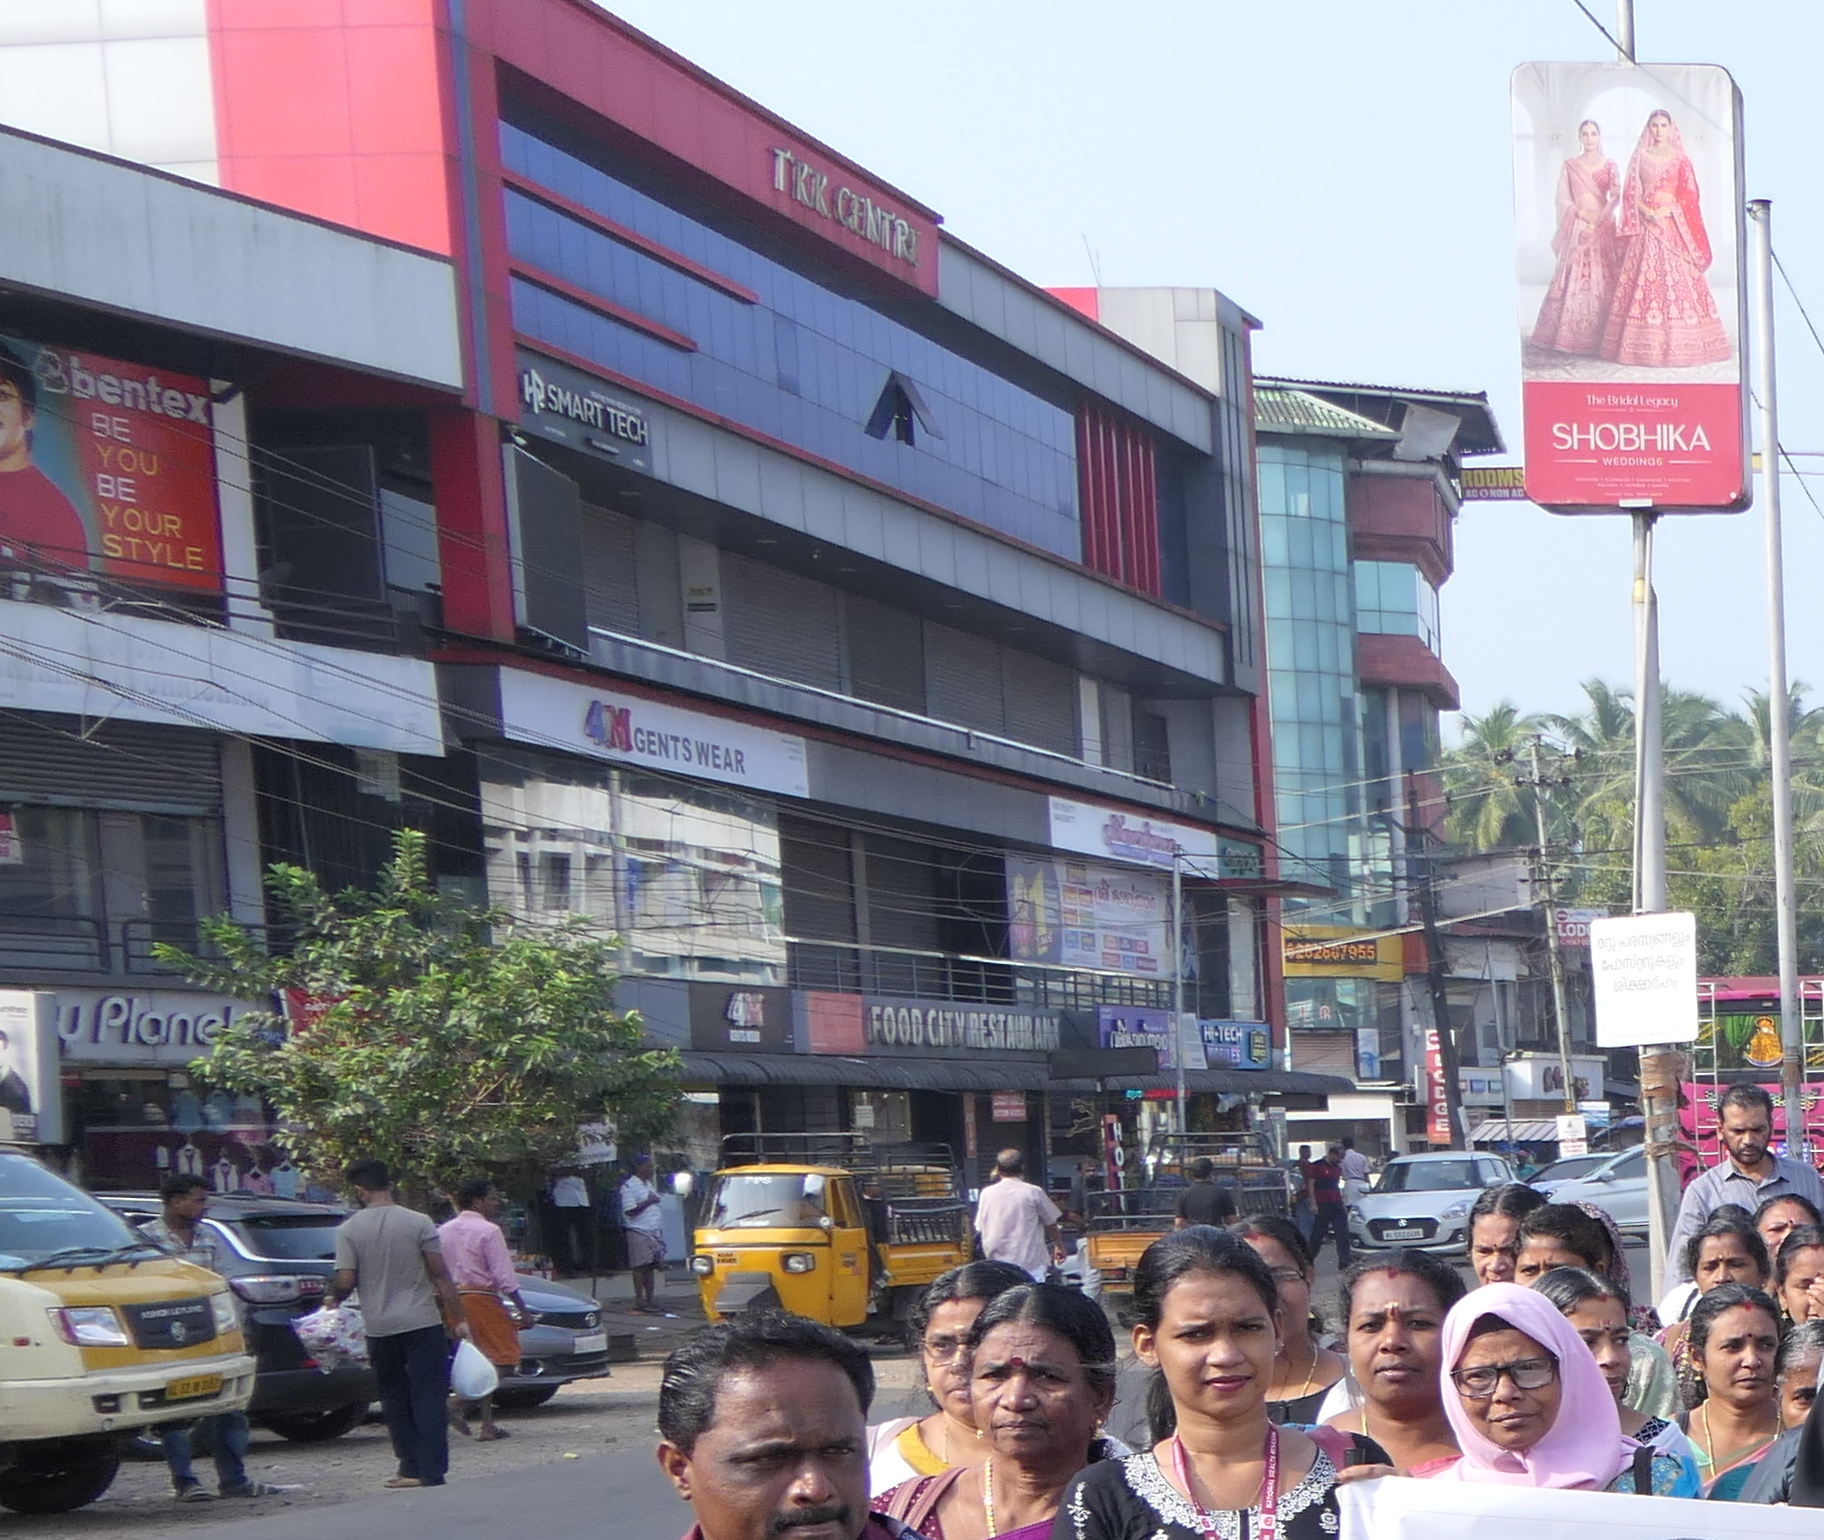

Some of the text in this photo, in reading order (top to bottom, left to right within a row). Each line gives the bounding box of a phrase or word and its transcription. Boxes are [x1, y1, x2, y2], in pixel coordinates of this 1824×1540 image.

[773, 148, 831, 218] TKK
[70, 356, 209, 424] bentex
[1587, 395, 1678, 408] The Bridal Legacy
[92, 413, 131, 442] BE
[547, 383, 604, 429] SMART
[606, 407, 649, 446] TECH
[1553, 423, 1711, 451] SHOBHIKA
[96, 443, 158, 476] YOU
[1602, 458, 1663, 466] WEDDINGS
[96, 473, 136, 502] BE
[1462, 469, 1523, 487] ROOMS
[101, 504, 182, 538] YOUR
[103, 534, 204, 570] STYLE
[633, 727, 692, 762] GENTS
[695, 740, 746, 774] WEAR
[869, 1005, 1060, 1051] FOOD CITY RESTAURANT
[1204, 1025, 1242, 1042] HI-TECH
